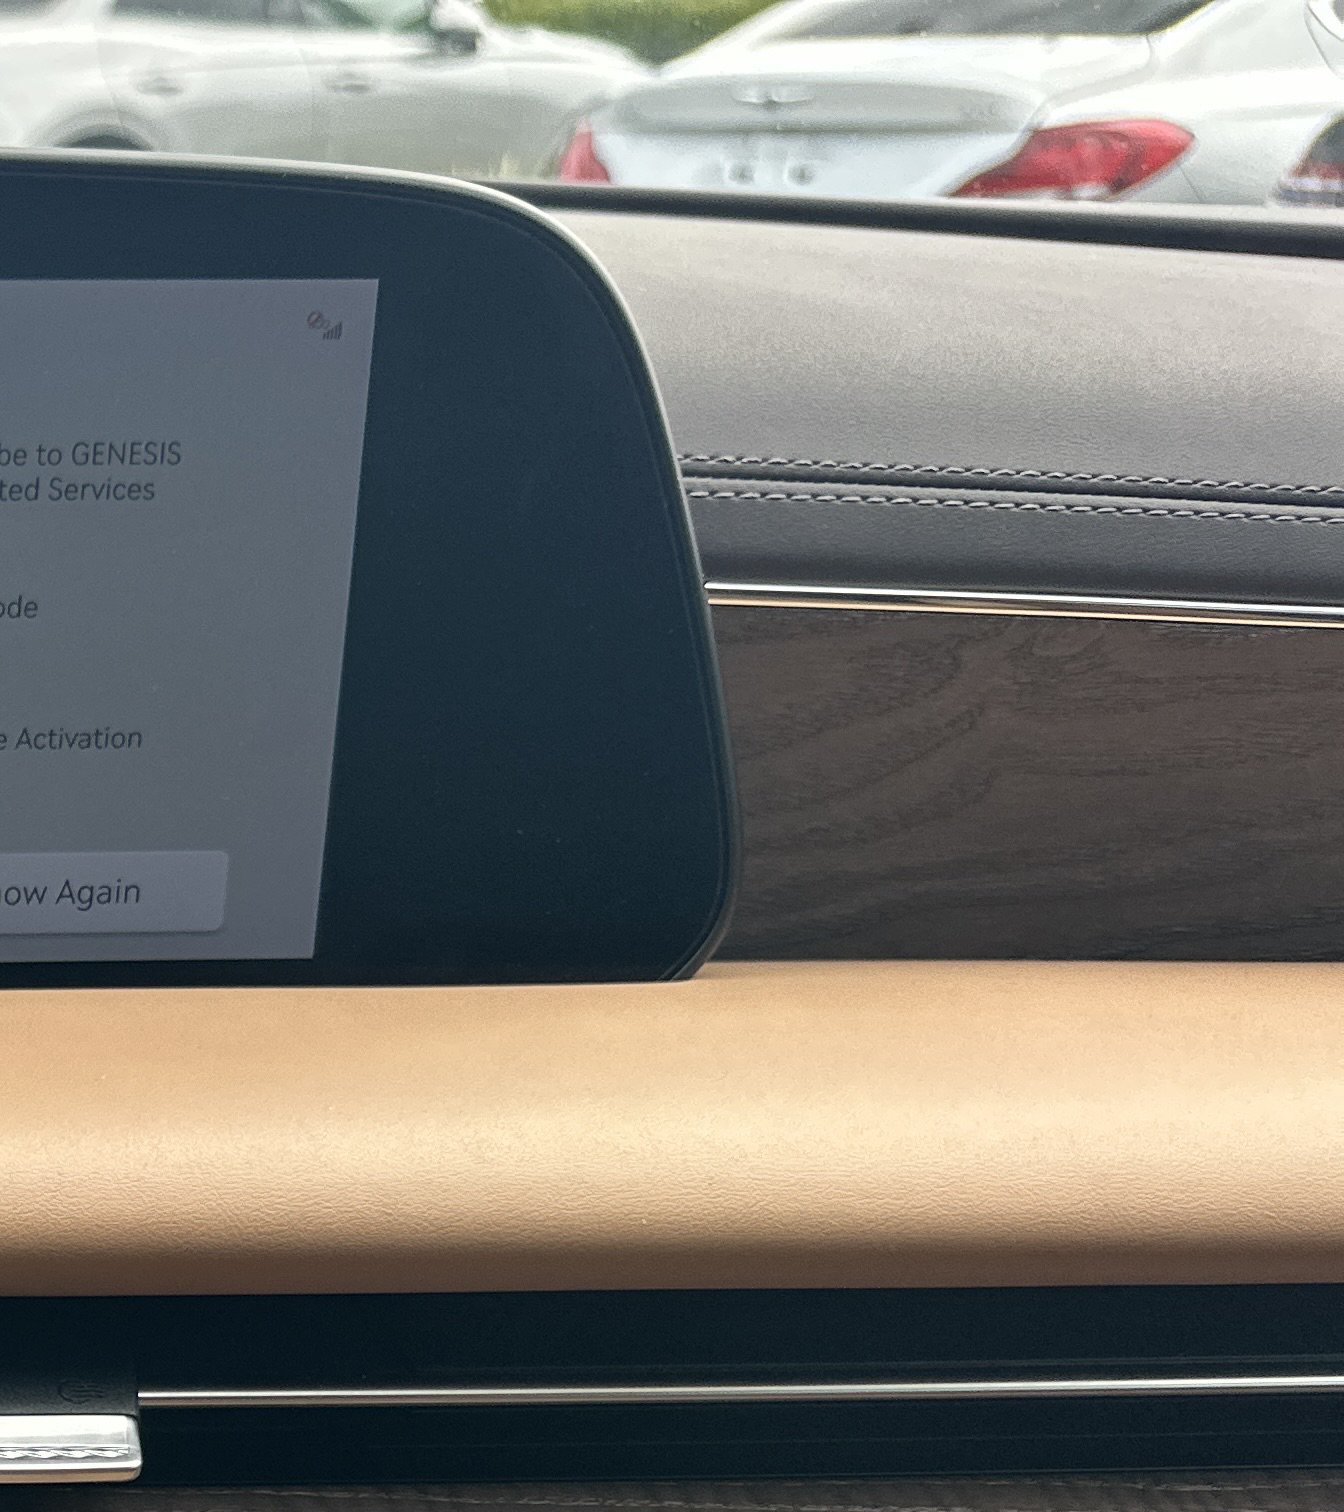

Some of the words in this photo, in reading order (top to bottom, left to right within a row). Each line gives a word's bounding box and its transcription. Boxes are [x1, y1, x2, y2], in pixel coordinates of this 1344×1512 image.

[36, 443, 63, 467] to
[71, 440, 182, 467] GENESIS
[48, 476, 156, 502] Services
[14, 726, 143, 751] Activation
[55, 878, 141, 912] Again
